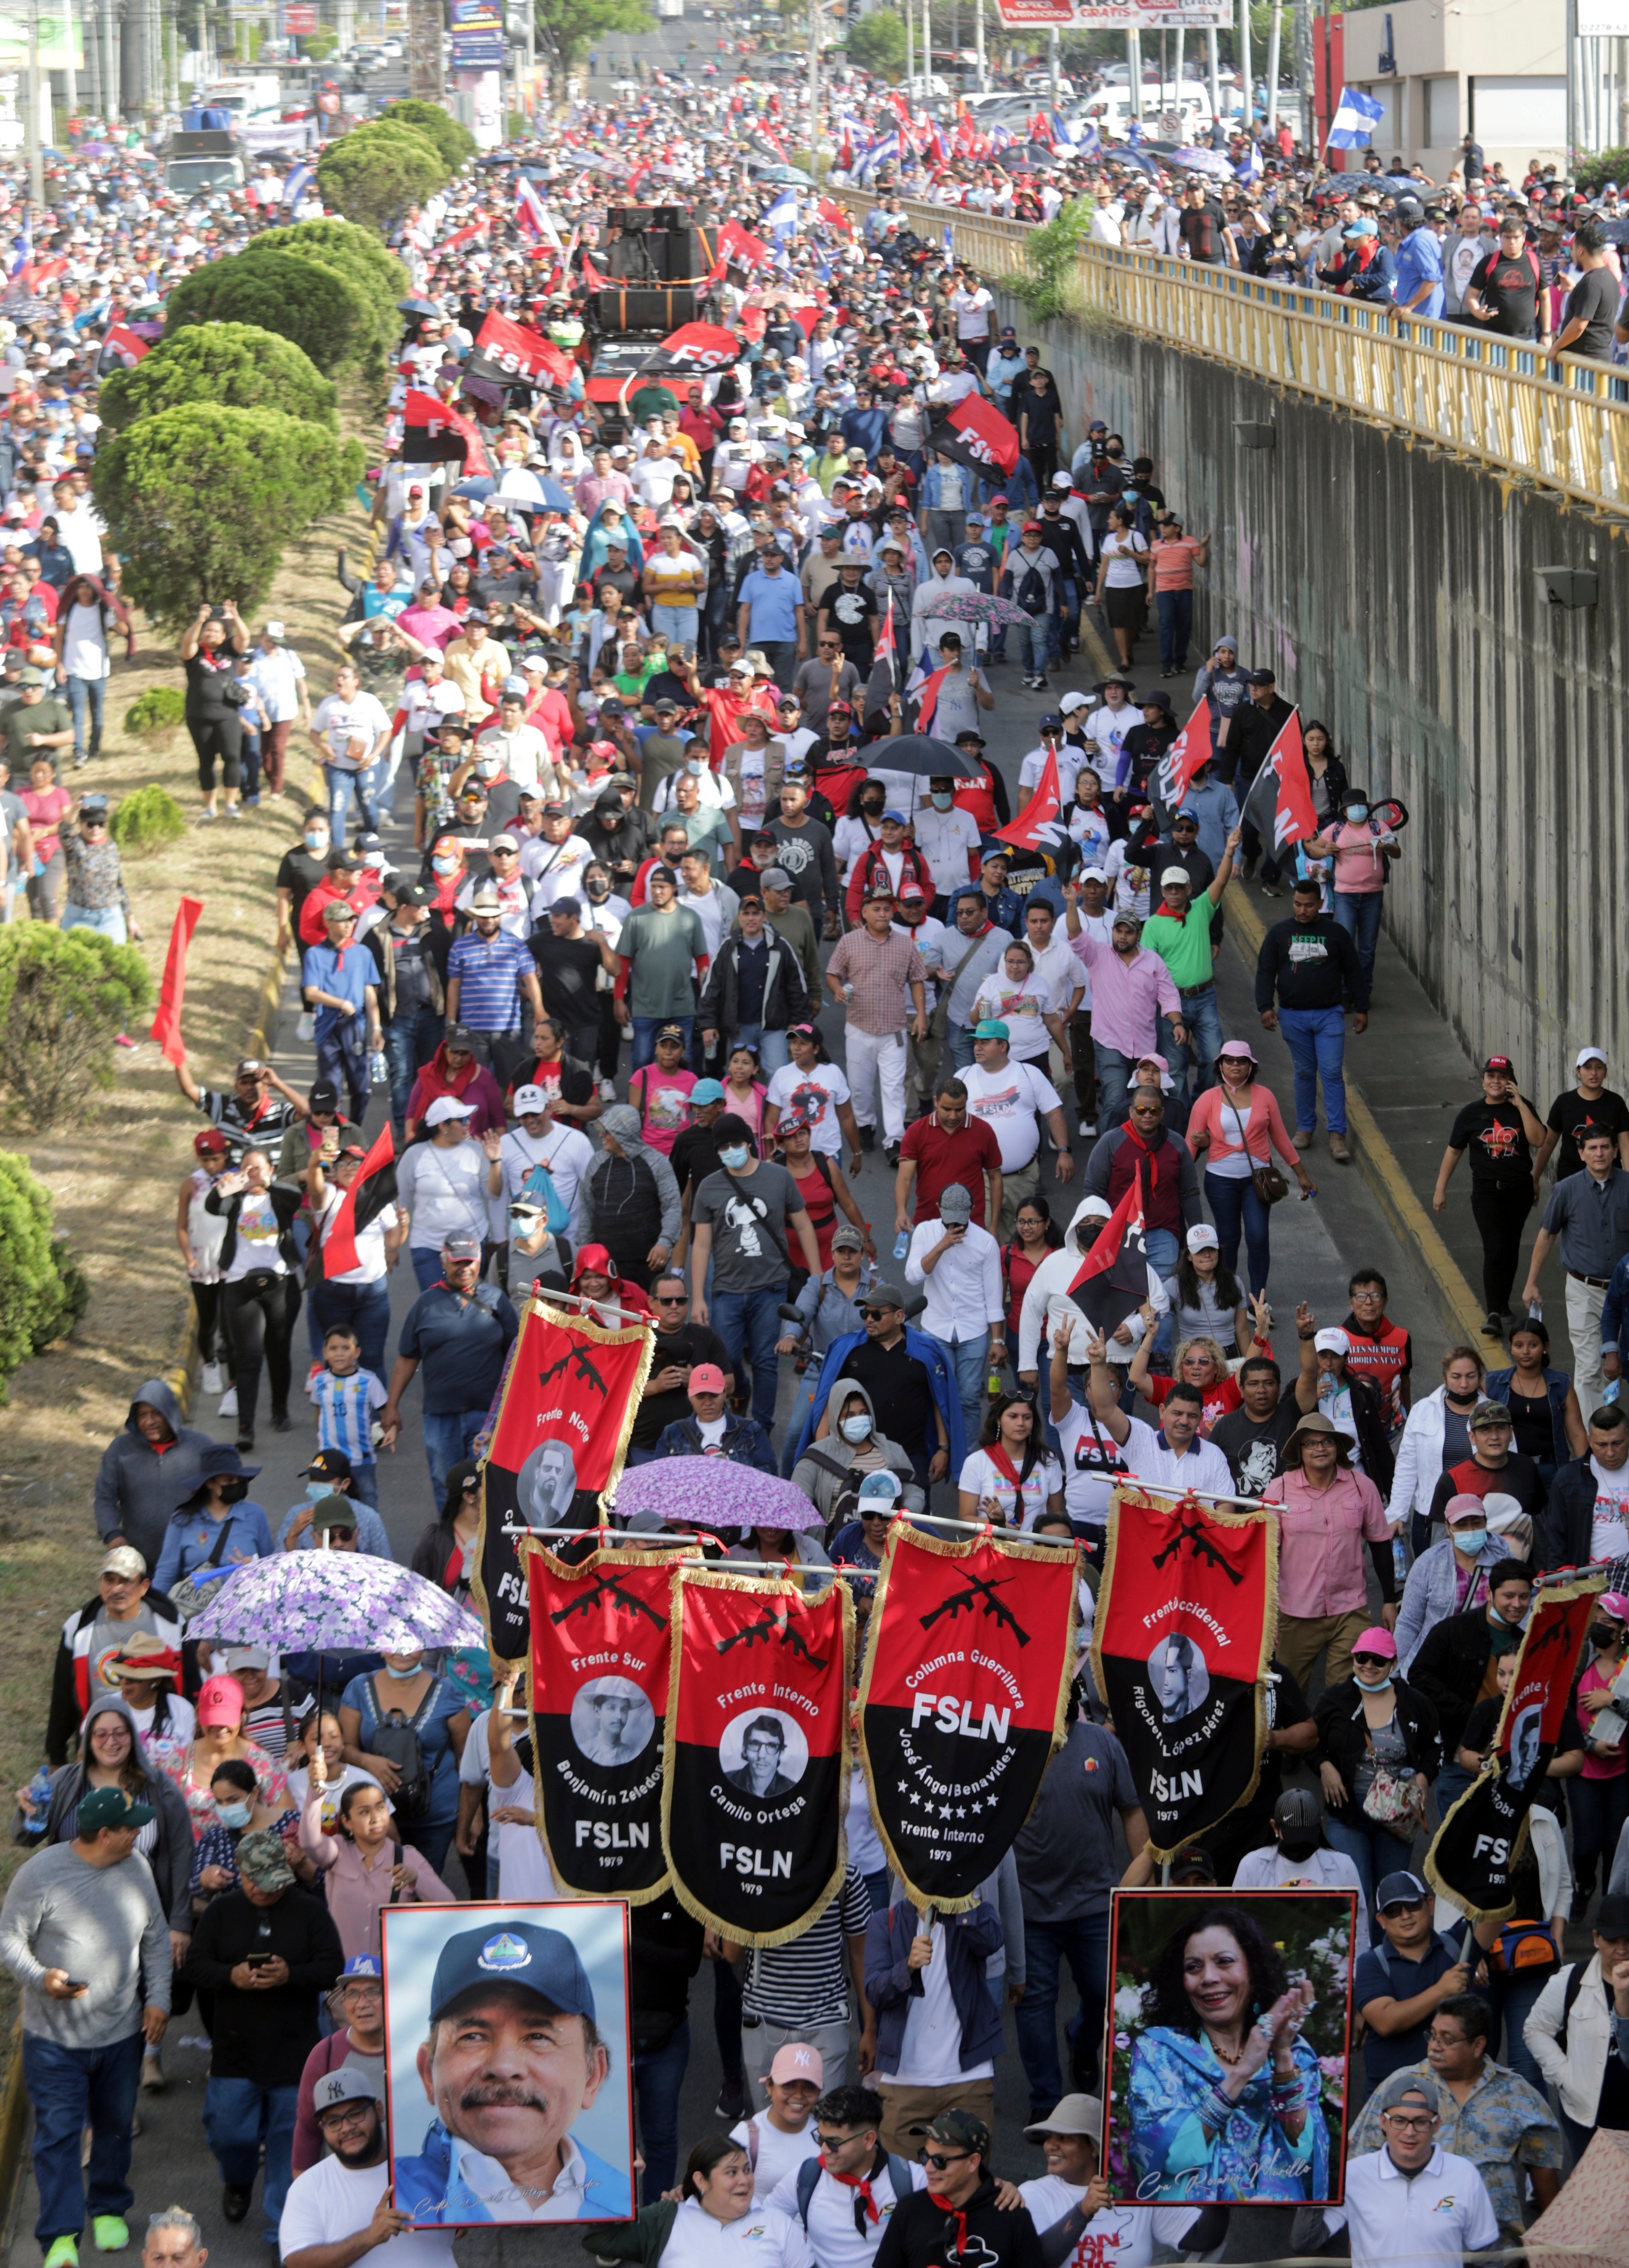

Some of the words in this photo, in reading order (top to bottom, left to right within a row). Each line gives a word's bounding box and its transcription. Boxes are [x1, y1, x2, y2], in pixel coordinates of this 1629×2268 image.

[1081, 7, 1131, 17] GRATIS
[483, 342, 555, 389] FSLN
[953, 777, 987, 790] FSLN
[983, 1104, 1011, 1114] FSLN
[780, 1120, 800, 1134] FSLN
[1368, 1346, 1400, 1355] SIEMPRE
[1380, 1356, 1402, 1365] NUNCA
[537, 1407, 563, 1427] Frente
[569, 1411, 590, 1443] Norte
[497, 1572, 531, 1608] FSL
[506, 1612, 523, 1626] 1979
[571, 1651, 618, 1672] Frente
[624, 1652, 647, 1672] Sur
[906, 1651, 964, 1688] Columna
[970, 1649, 1024, 1710] Guerrillera
[717, 1682, 765, 1709] Frente
[773, 1683, 819, 1717] Interno
[911, 1692, 1011, 1744] FSLN
[1162, 1732, 1202, 1757] López
[900, 1728, 923, 1765] José
[954, 1746, 1017, 1797] Benavidez
[557, 1760, 616, 1805] Benjamín
[710, 1785, 752, 1822] Camilo
[757, 1796, 806, 1824] Ortega
[1157, 1810, 1178, 1821] 1979
[575, 1820, 649, 1849] FSLN
[901, 1820, 939, 1840] Frente
[943, 1827, 985, 1844] Interno
[598, 1856, 624, 1867] 1979
[720, 1842, 793, 1879] FSLN
[929, 1849, 952, 1862] 1979
[741, 1881, 763, 1896] 1979
[352, 1958, 376, 1975] LA
[794, 2049, 810, 2068] NY
[327, 2081, 345, 2100] NY
[1175, 2167, 1242, 2193] Rosario
[1249, 2147, 1312, 2185] Murillo
